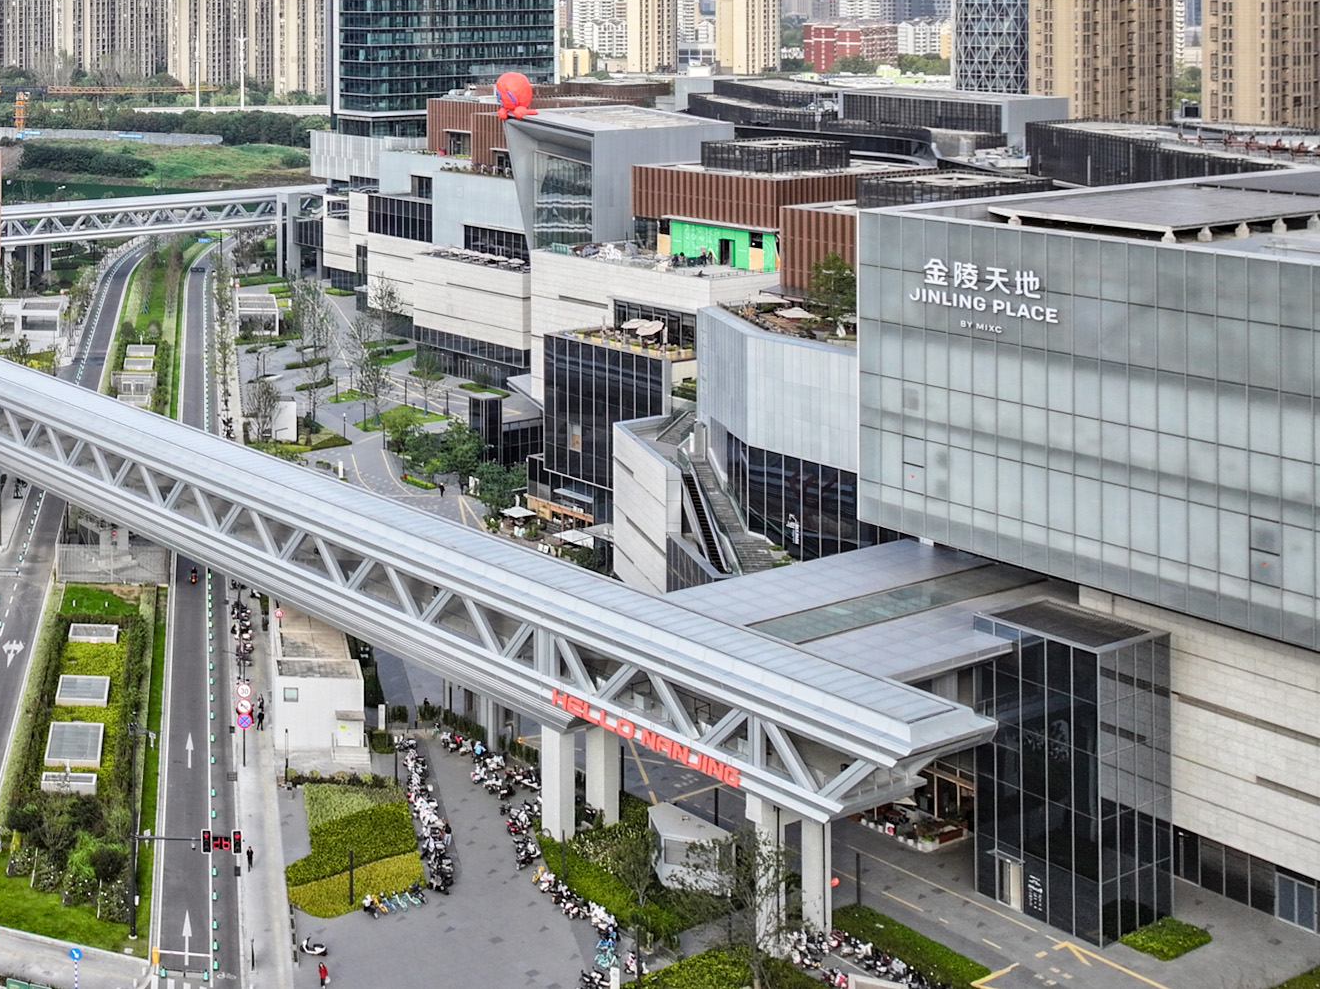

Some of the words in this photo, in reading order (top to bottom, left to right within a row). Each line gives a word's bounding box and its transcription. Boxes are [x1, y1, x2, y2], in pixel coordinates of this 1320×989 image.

[923, 258, 1041, 299] 金陵天地
[909, 287, 986, 311] JINLING
[992, 299, 1059, 323] PLACE
[960, 320, 973, 328] BY
[976, 323, 1002, 333] MIXC
[551, 688, 635, 739] HELLO
[640, 728, 740, 788] NANJING
